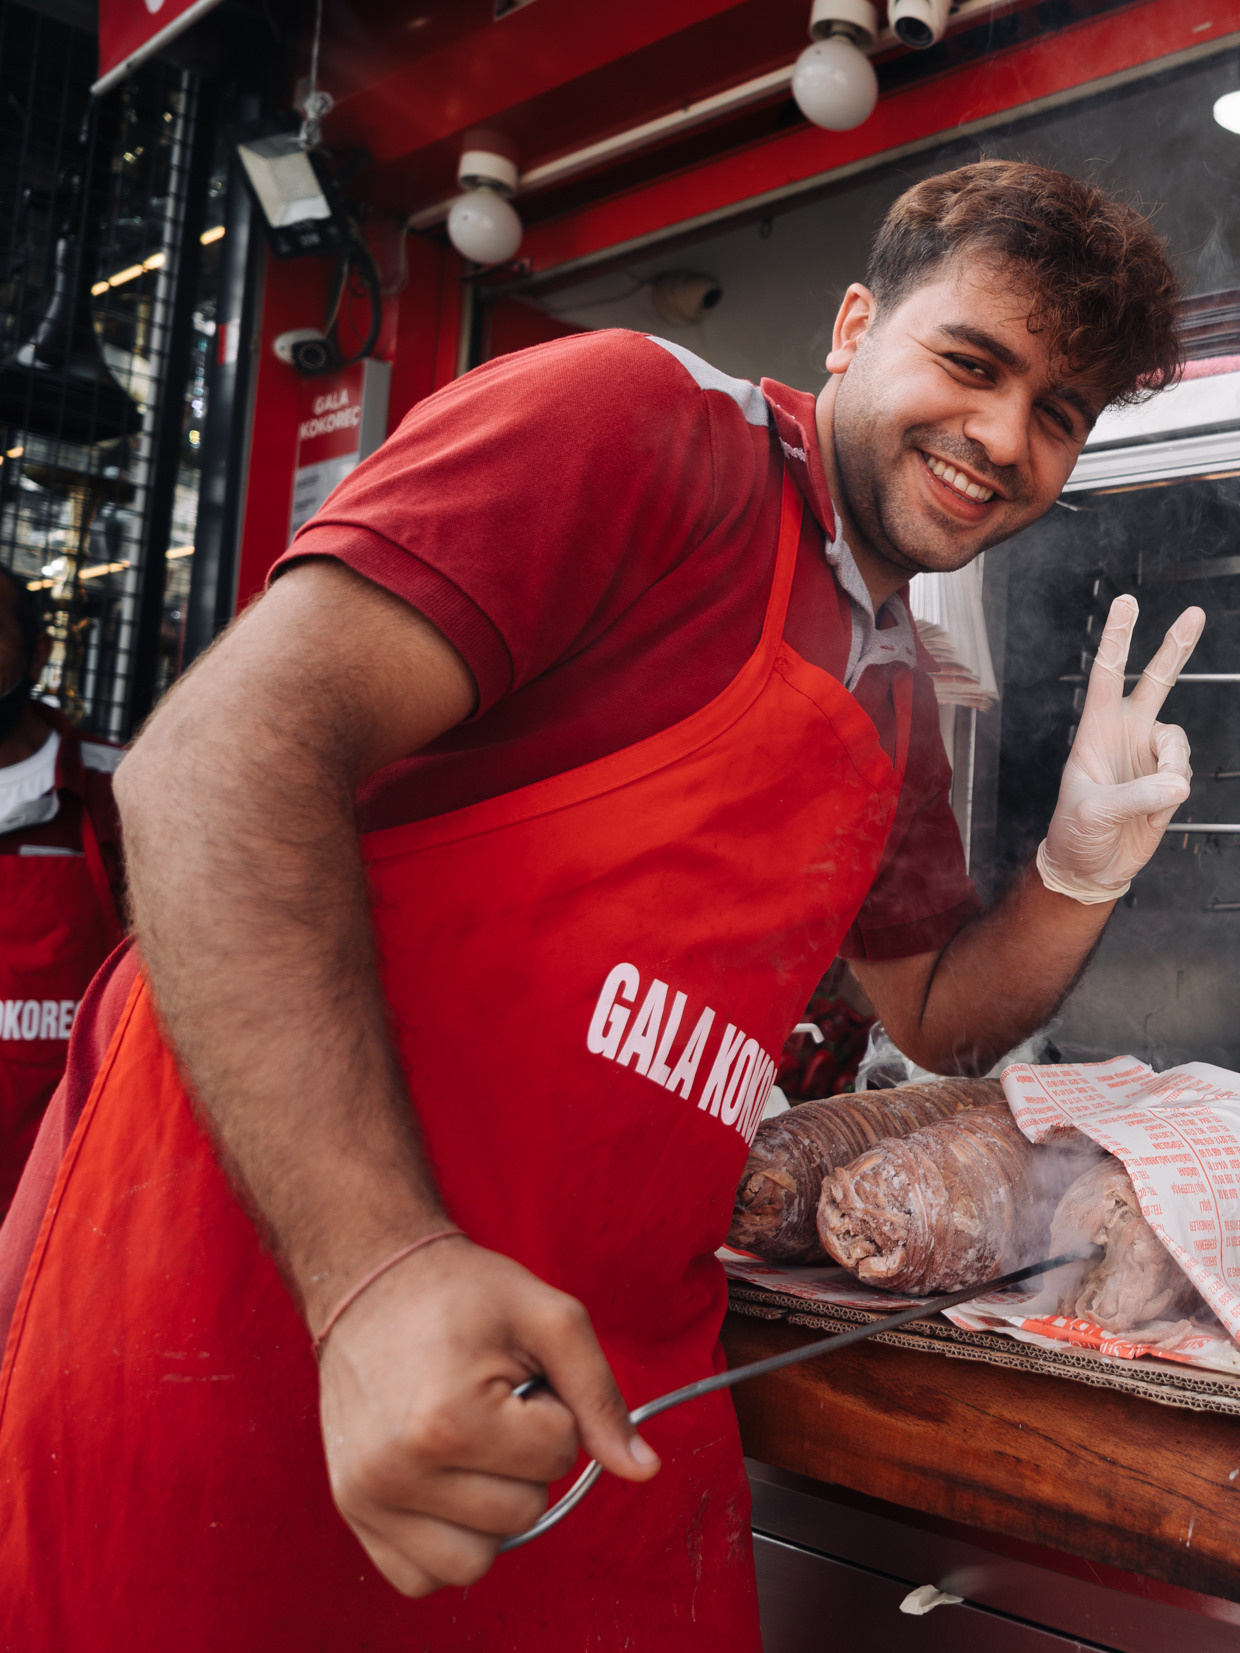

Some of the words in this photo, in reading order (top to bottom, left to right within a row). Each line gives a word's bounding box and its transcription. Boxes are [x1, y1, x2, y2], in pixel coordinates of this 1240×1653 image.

[313, 388, 349, 415] GALA
[0, 999, 79, 1041] KORE
[586, 962, 716, 1100] GALA
[697, 1022, 778, 1148] KOKO
